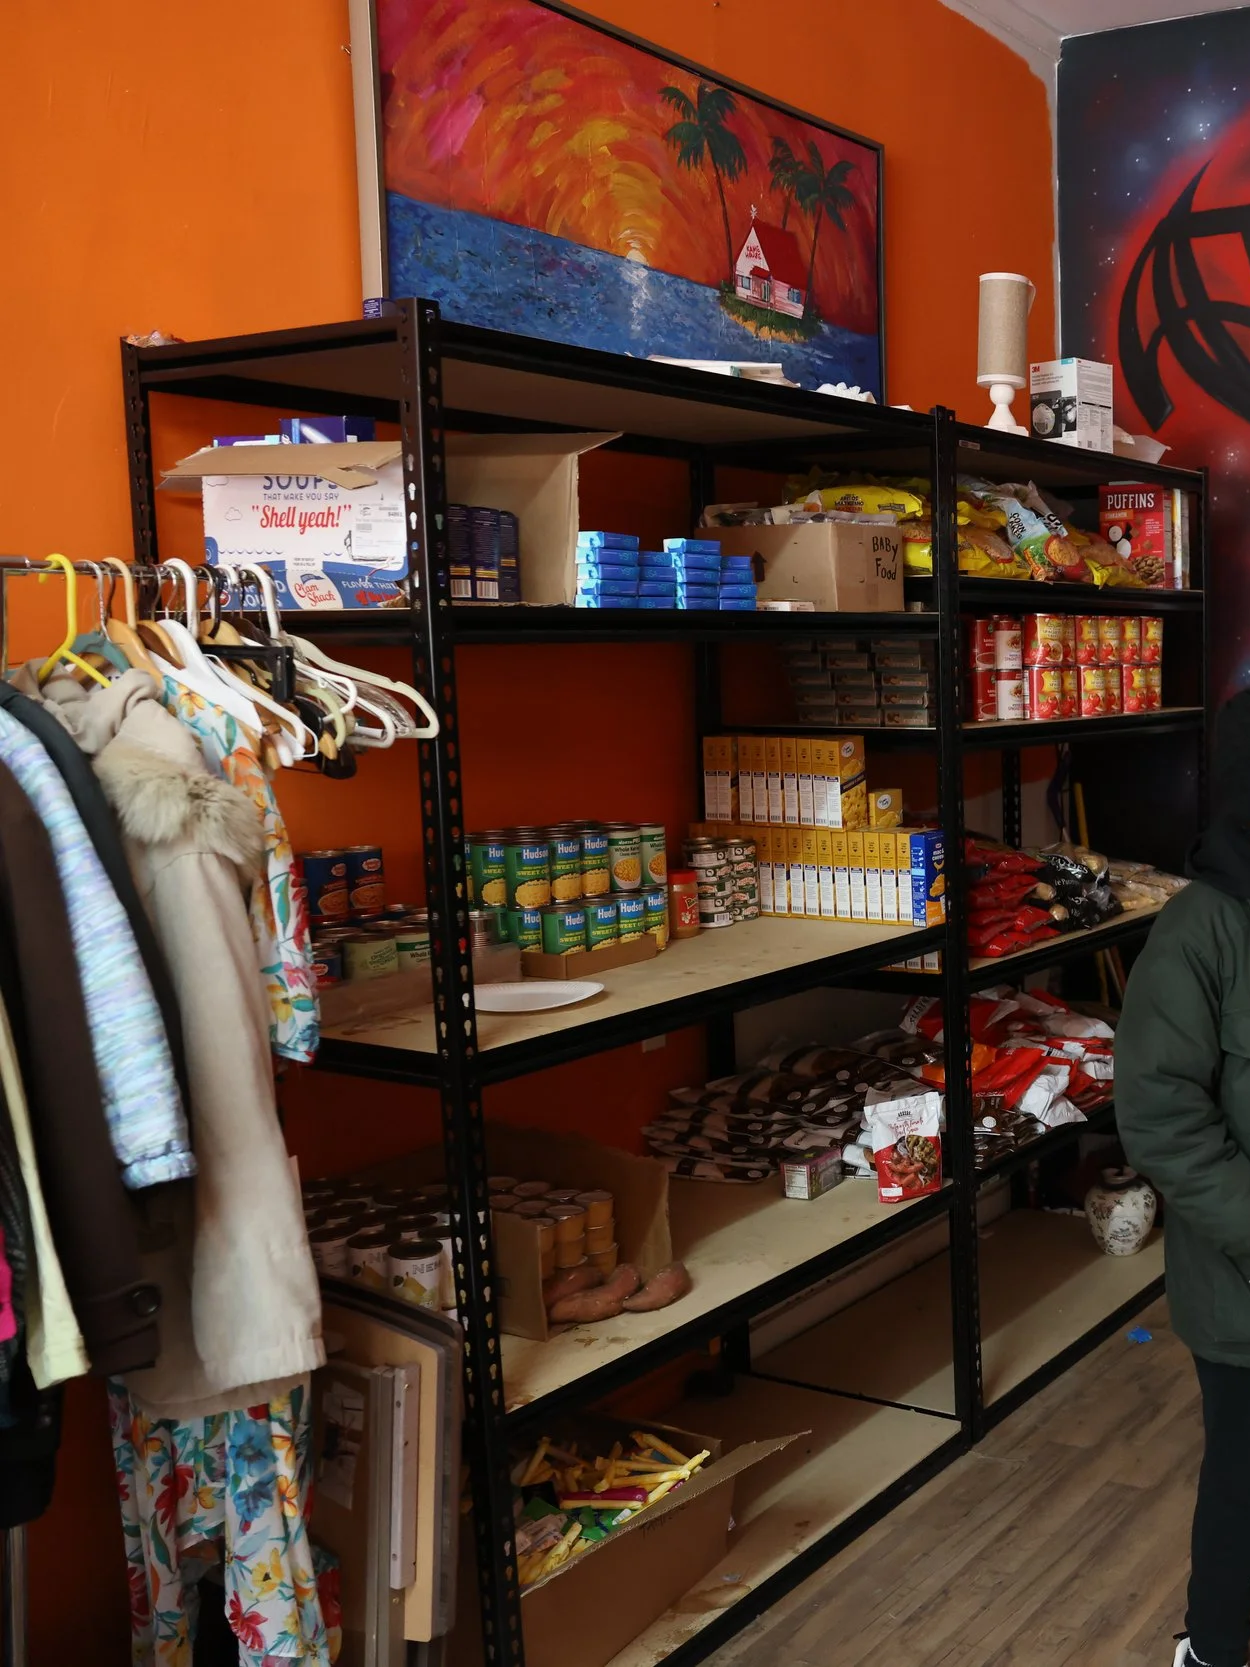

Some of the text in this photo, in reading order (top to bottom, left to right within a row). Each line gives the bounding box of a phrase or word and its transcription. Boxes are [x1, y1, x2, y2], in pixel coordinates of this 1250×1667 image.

[1107, 493, 1155, 510] PUFFINS
[875, 558, 897, 580] Food
[294, 583, 319, 598] Clam
[306, 590, 336, 607] Shack
